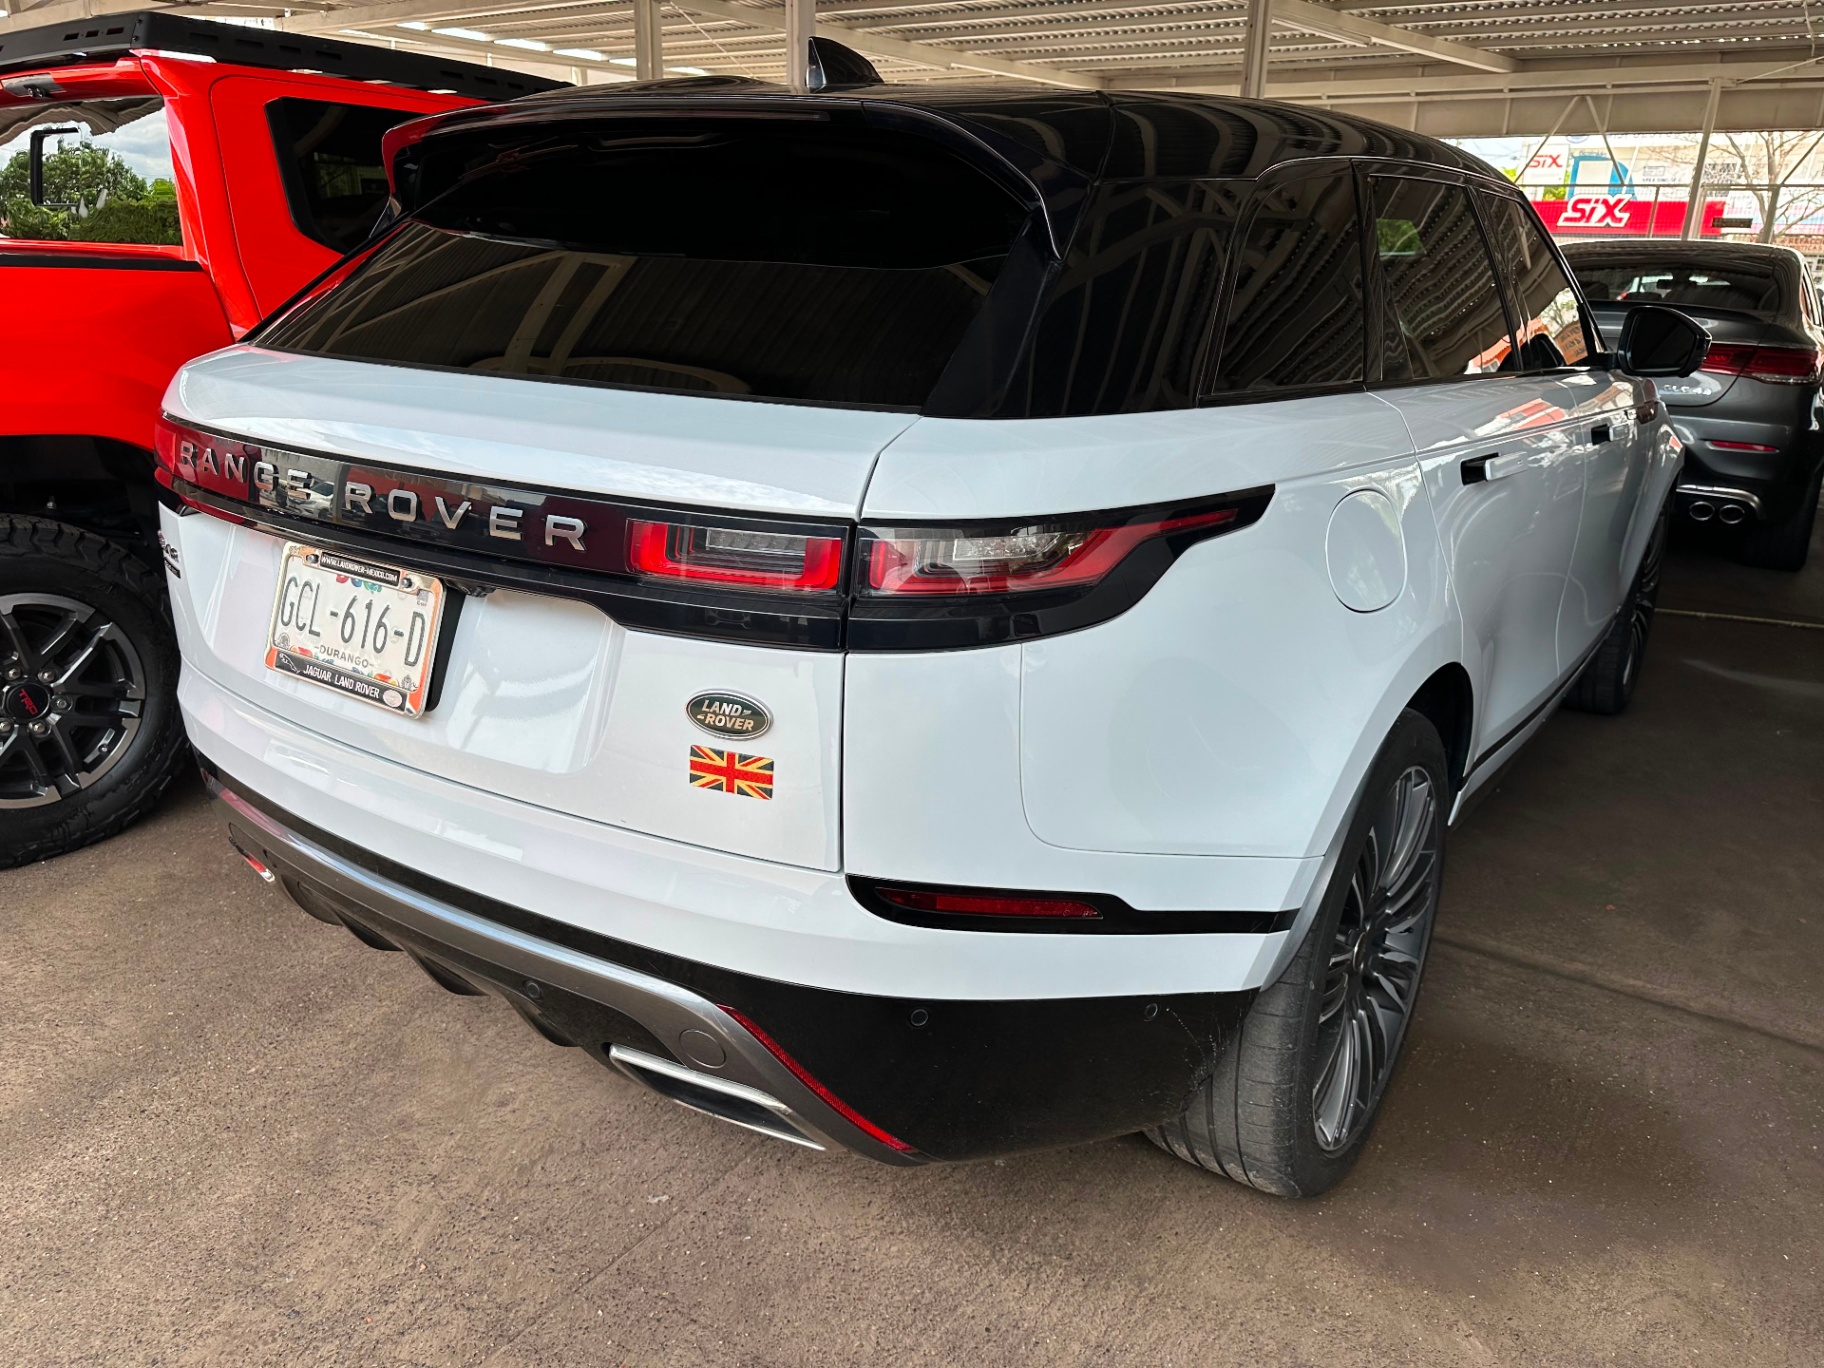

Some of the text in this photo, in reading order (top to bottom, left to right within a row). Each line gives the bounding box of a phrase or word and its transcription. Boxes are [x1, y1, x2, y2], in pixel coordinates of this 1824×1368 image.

[1788, 237, 1824, 245] REFACCI
[179, 440, 586, 551] RANGE ROVER
[280, 576, 426, 668] GCL-616-D
[303, 664, 380, 699] JAGUAR LAND ROVER
[19, 688, 38, 715] TRD
[702, 699, 743, 716] LAND
[704, 713, 754, 731] ROVER
